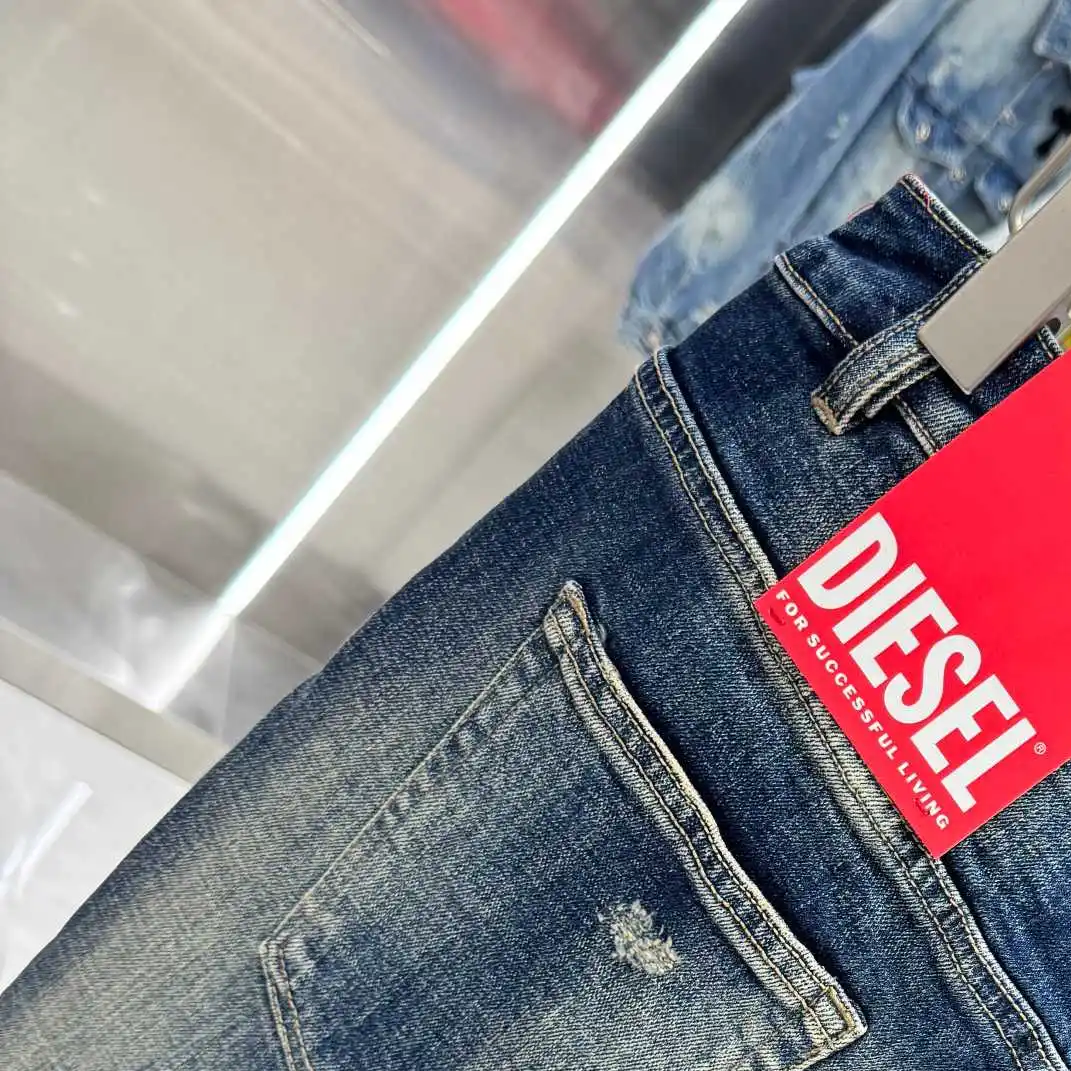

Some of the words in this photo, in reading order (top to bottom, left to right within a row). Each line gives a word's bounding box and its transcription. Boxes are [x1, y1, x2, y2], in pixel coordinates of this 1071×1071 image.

[775, 589, 807, 631] FOR
[807, 635, 899, 761] SUCCESSFUL
[896, 760, 950, 831] LIVING
[798, 512, 1037, 813] DIESEL
